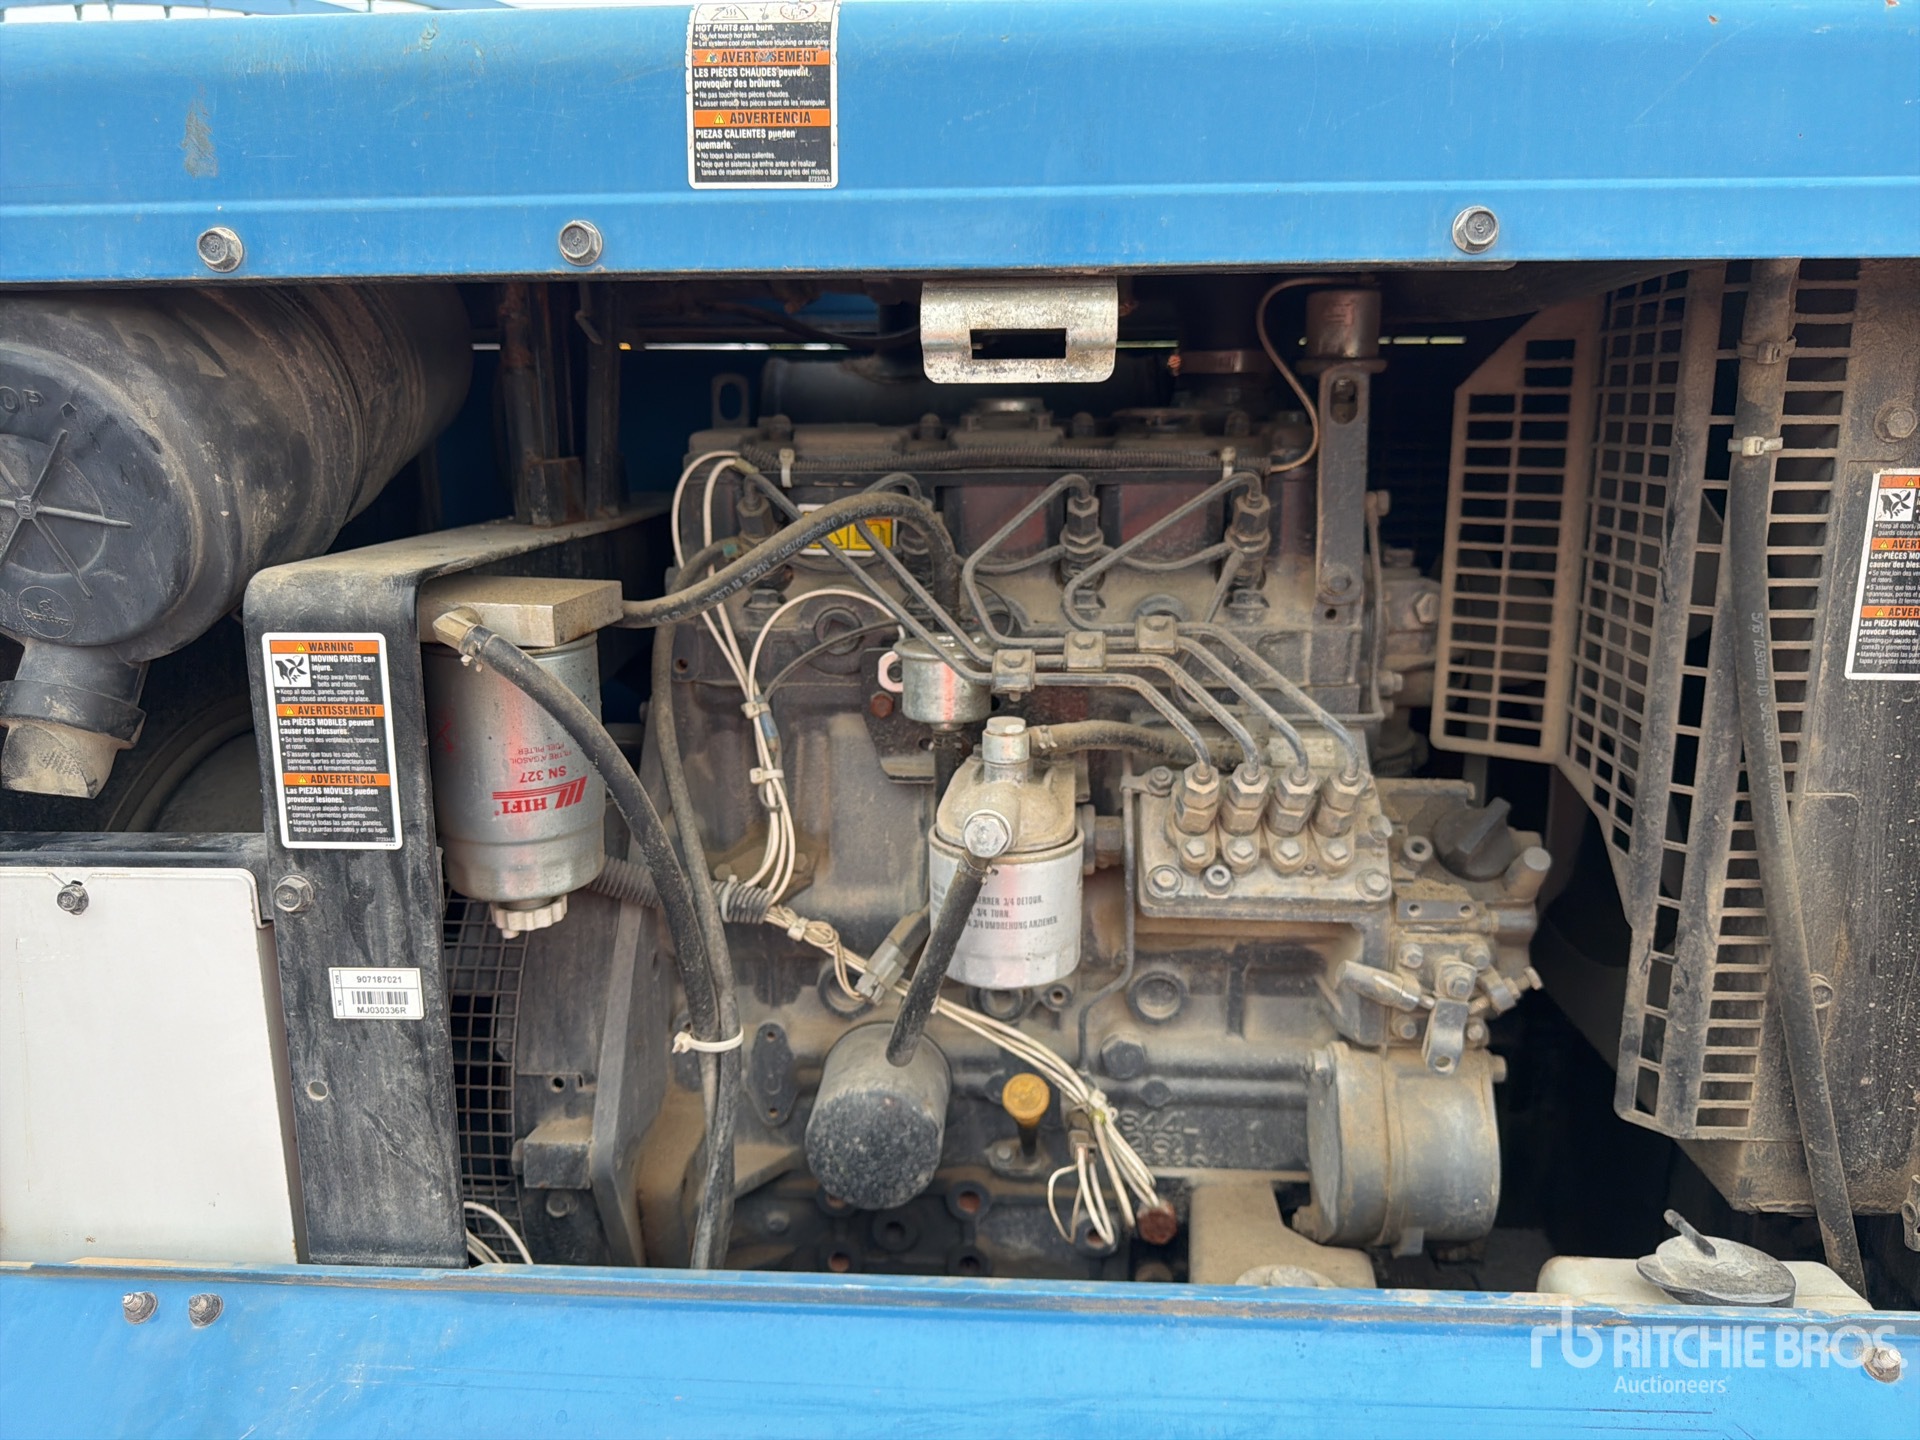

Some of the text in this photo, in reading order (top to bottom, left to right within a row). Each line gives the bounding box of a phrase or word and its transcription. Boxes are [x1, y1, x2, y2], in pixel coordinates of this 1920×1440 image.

[721, 51, 818, 63] AVERTSEMENT
[694, 69, 708, 77] LES
[711, 67, 738, 77] PIÈCES
[740, 68, 777, 77] CHAUDES
[695, 80, 731, 90] provoquer
[749, 79, 782, 88] brûlures.
[800, 100, 826, 108] manipuler.
[730, 112, 811, 124] ADVERTENCIA
[696, 129, 795, 140] PIEZAS CALIENTES pueden
[696, 140, 733, 151] quemarle.
[1874, 619, 1897, 627] PIEZAS
[309, 643, 353, 651] WARNING
[312, 664, 332, 672] injure.
[298, 706, 376, 715] AVERTISSEMENT
[292, 717, 315, 726] PIÈCES
[317, 718, 347, 726] MOBILES
[349, 719, 374, 727] peuvent
[520, 765, 567, 783] SN 327
[311, 775, 376, 784] ADVERTENCIA
[299, 787, 322, 795] PIEZAS
[324, 786, 353, 795] MÓVILES
[355, 788, 378, 796] pueden
[502, 797, 548, 814] HIFI
[356, 976, 402, 984] 907187021
[356, 1007, 407, 1015] MJ030336R
